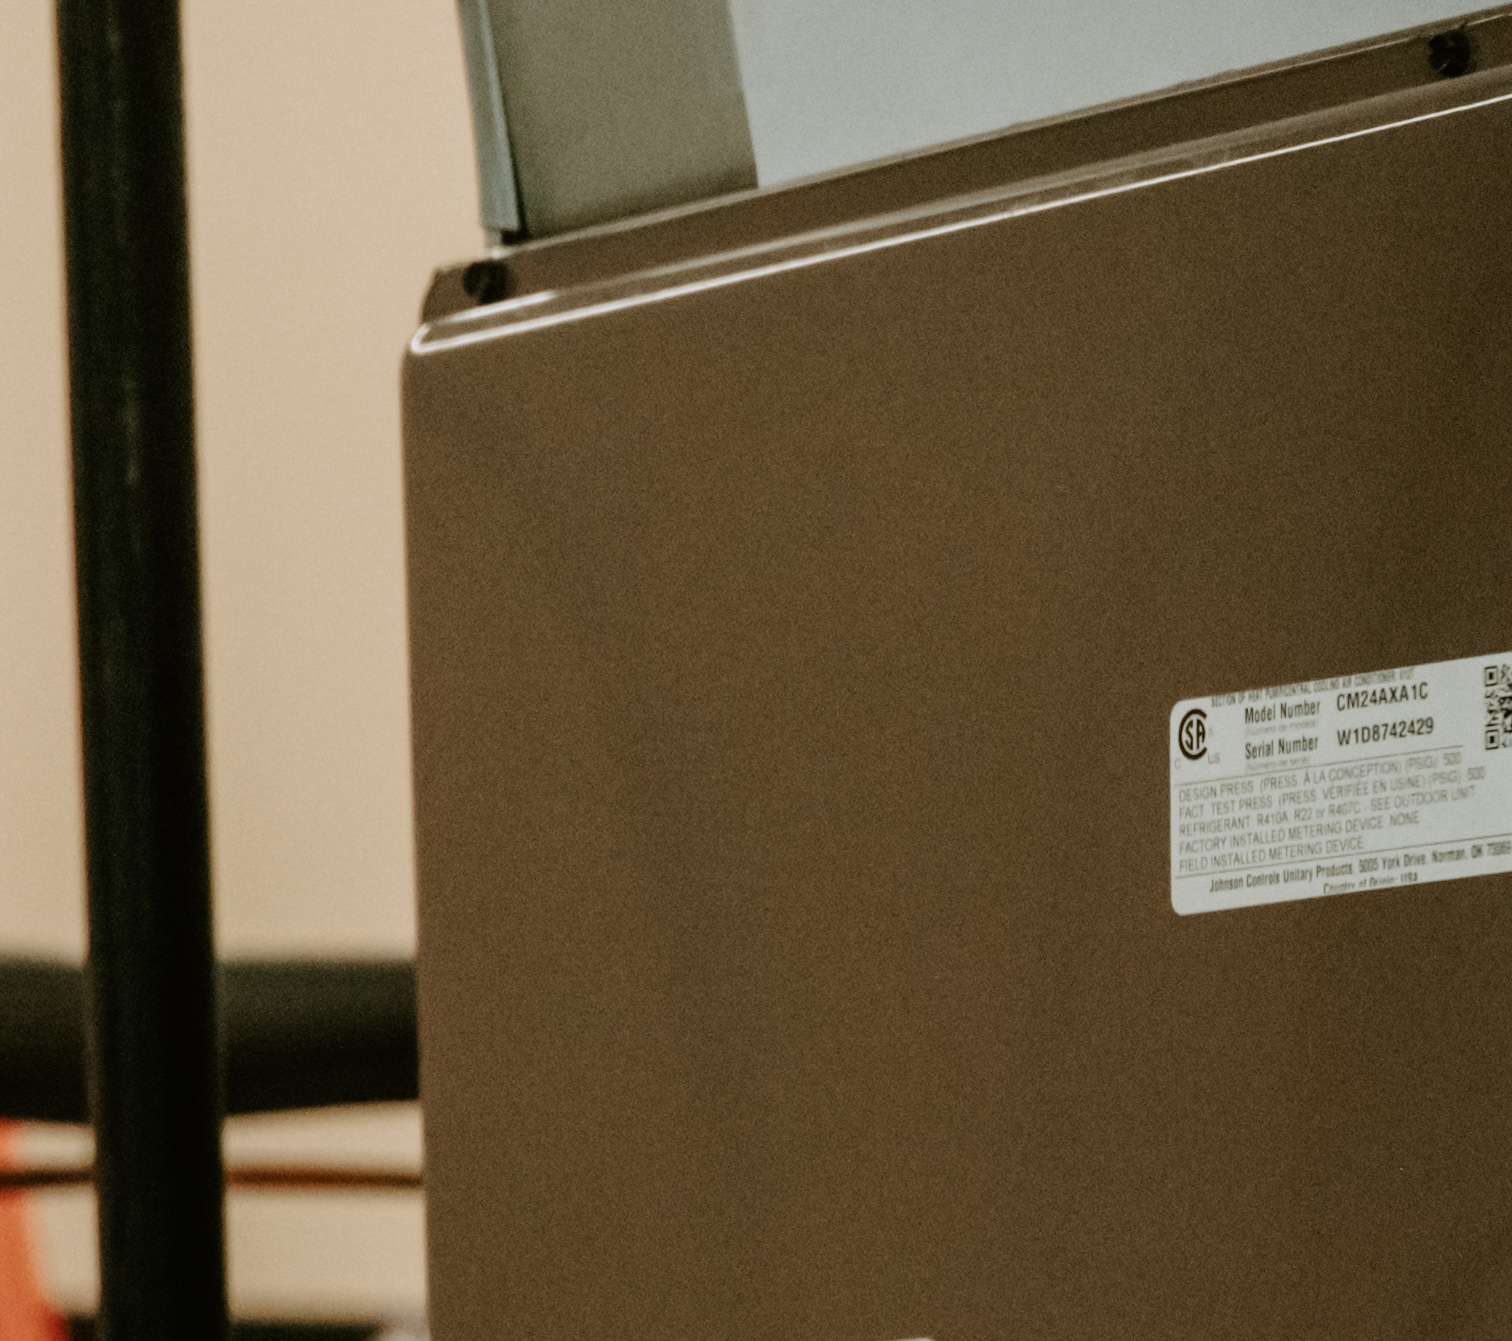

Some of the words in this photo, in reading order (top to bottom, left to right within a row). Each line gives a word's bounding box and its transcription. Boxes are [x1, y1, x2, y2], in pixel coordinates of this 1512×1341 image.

[1244, 703, 1275, 724] Model
[1280, 697, 1320, 719] Number
[1336, 682, 1428, 711] CM24AXA1C
[1245, 739, 1273, 760] Serial
[1278, 732, 1318, 755] Number
[1337, 716, 1434, 747] W1D8742429
[1178, 785, 1216, 803] DESIGN
[1211, 799, 1236, 815] TEST
[1372, 778, 1386, 793] EN
[1179, 835, 1226, 856] FACTORY
[1230, 827, 1285, 849] INSTALLED
[1287, 819, 1342, 841] METERING
[1179, 856, 1208, 874] FIELD
[1211, 848, 1266, 869] INSTALLED
[1268, 840, 1323, 861] METERING
[1209, 875, 1243, 894] Johnson
[1245, 870, 1281, 889] Controls
[1282, 866, 1313, 885] Unitary
[1381, 854, 1401, 871] York
